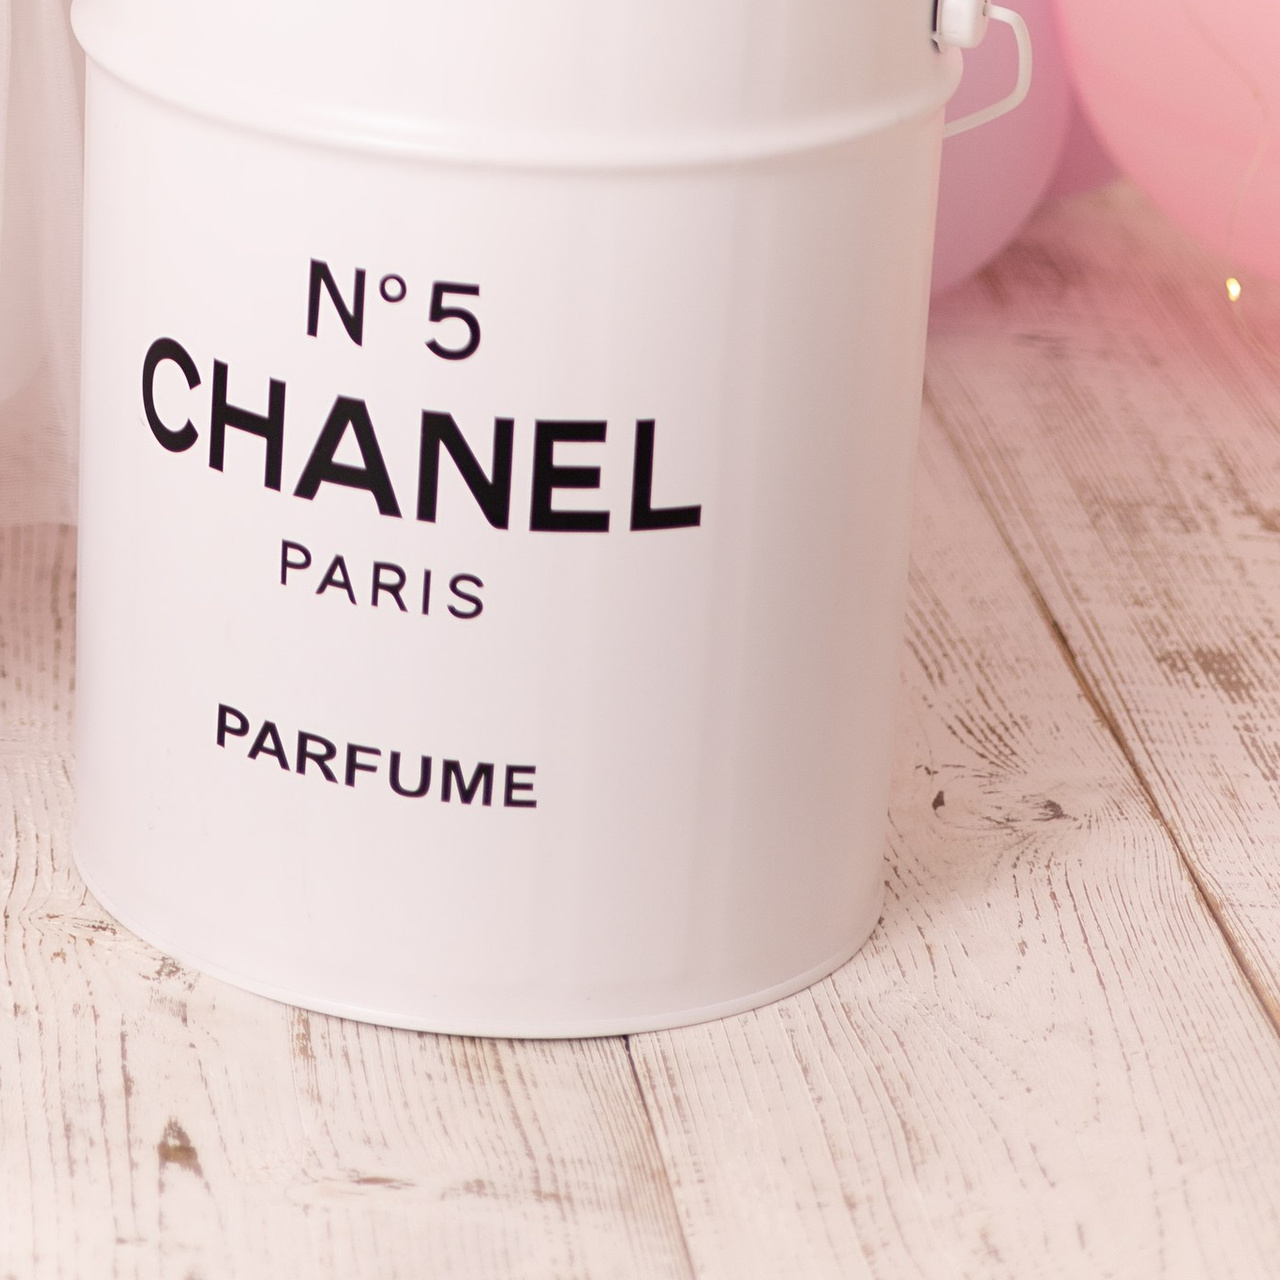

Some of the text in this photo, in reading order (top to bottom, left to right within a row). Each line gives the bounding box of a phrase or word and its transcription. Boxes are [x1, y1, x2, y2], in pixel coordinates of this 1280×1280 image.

[141, 336, 703, 533] CHANEL
[279, 538, 485, 621] PARIS
[215, 702, 538, 810] PARFUME
